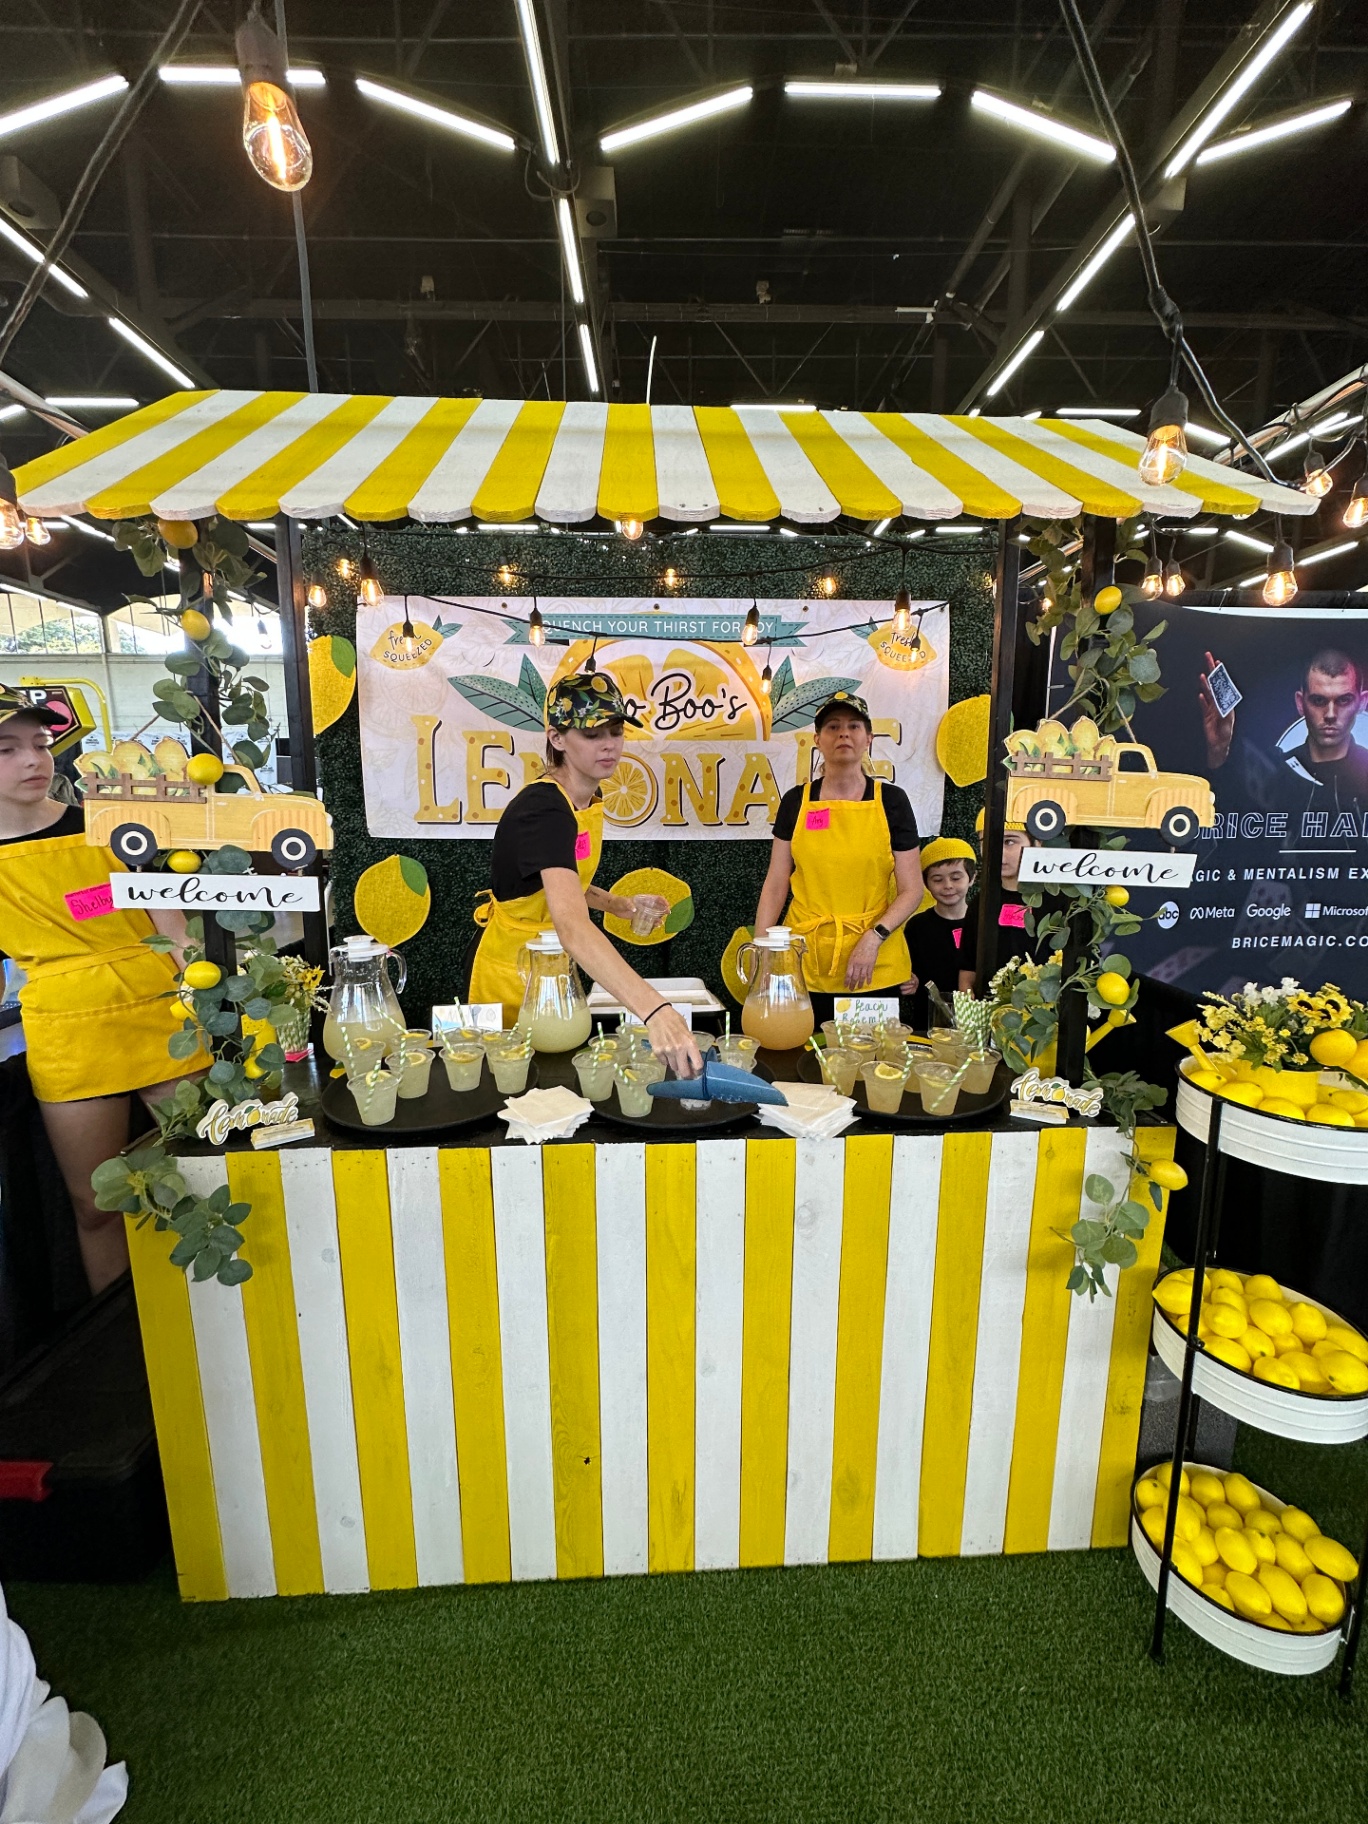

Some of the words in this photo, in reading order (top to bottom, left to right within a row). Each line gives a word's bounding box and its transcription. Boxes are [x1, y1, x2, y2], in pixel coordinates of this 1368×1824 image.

[542, 619, 602, 635] QUENCH
[607, 620, 649, 633] YOUR
[653, 620, 707, 634] THIRST
[711, 620, 741, 634] FOR
[383, 638, 433, 663] SQUEEZED
[651, 672, 748, 731] Boo's
[1195, 811, 1289, 840] RICE
[1033, 852, 1179, 884] welcome
[1227, 868, 1237, 881] &
[1243, 867, 1340, 881] MENTALISM
[127, 876, 304, 908] welcome
[70, 894, 115, 916] Shelby
[1205, 906, 1236, 919] Meta
[1246, 903, 1292, 920] Google
